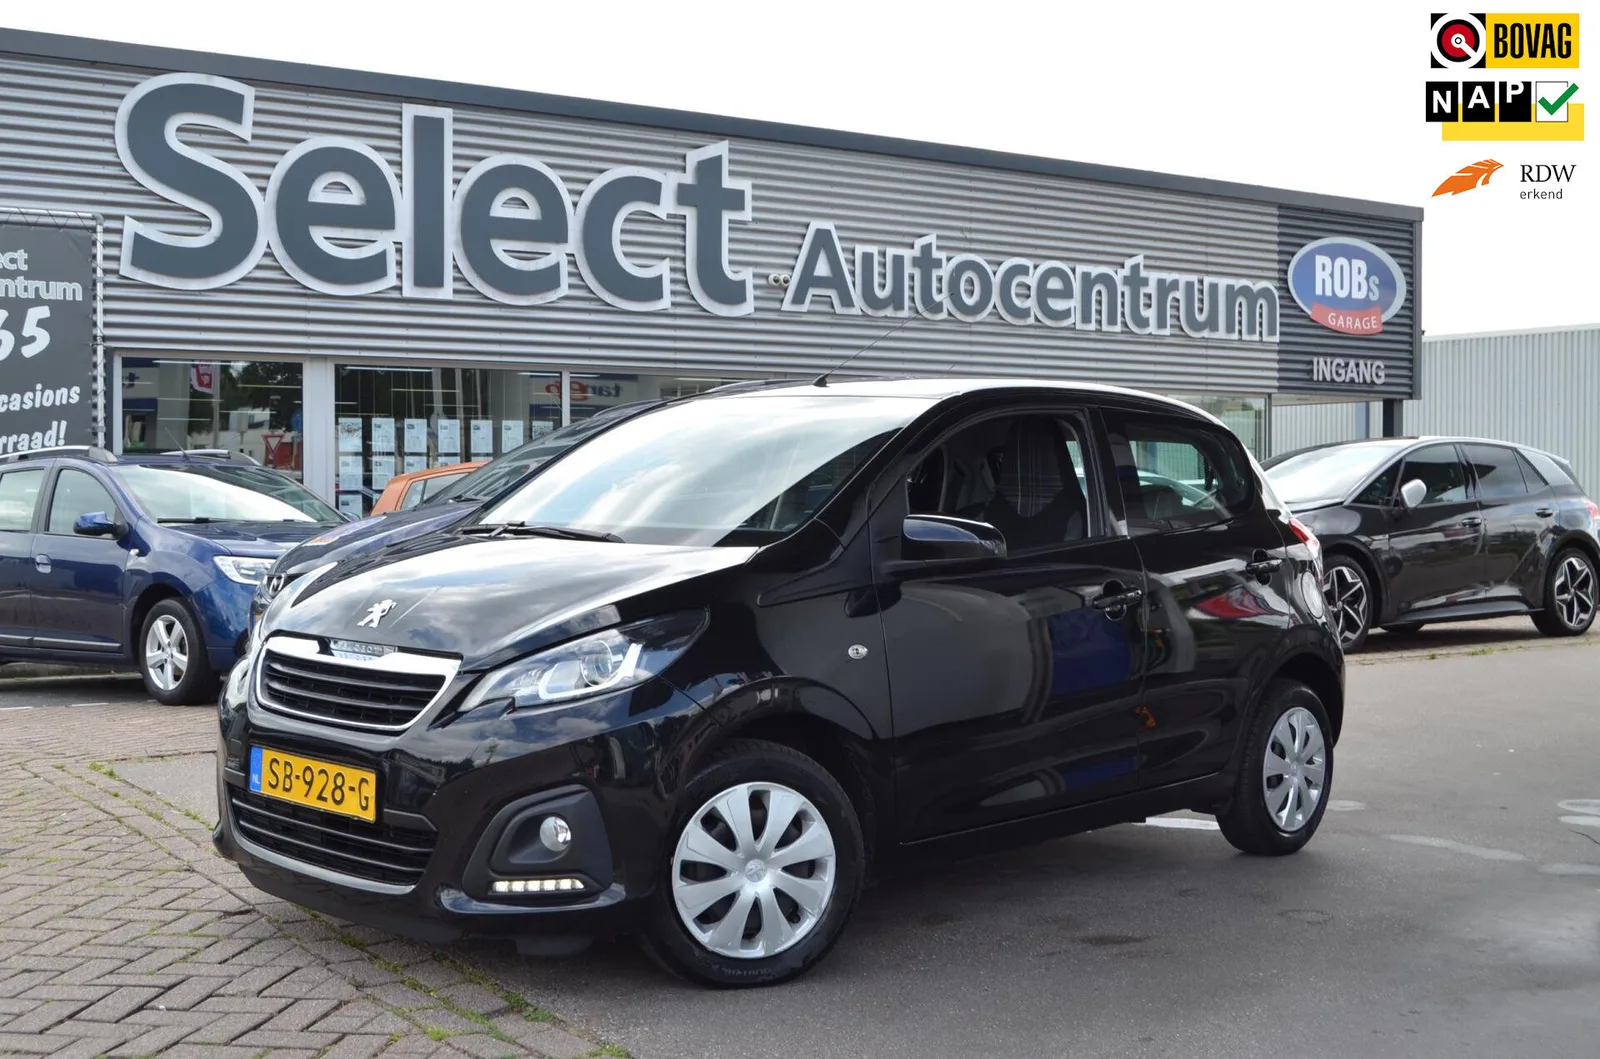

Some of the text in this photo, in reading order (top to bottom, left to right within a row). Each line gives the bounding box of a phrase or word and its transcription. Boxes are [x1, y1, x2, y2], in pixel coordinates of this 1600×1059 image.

[115, 72, 1281, 344] Select Autocentrum
[1315, 254, 1380, 302] ROBs
[1327, 312, 1378, 330] GARAGE
[1312, 356, 1386, 385] INGANG
[252, 773, 261, 785] NL
[267, 757, 370, 812] SB-928-G
